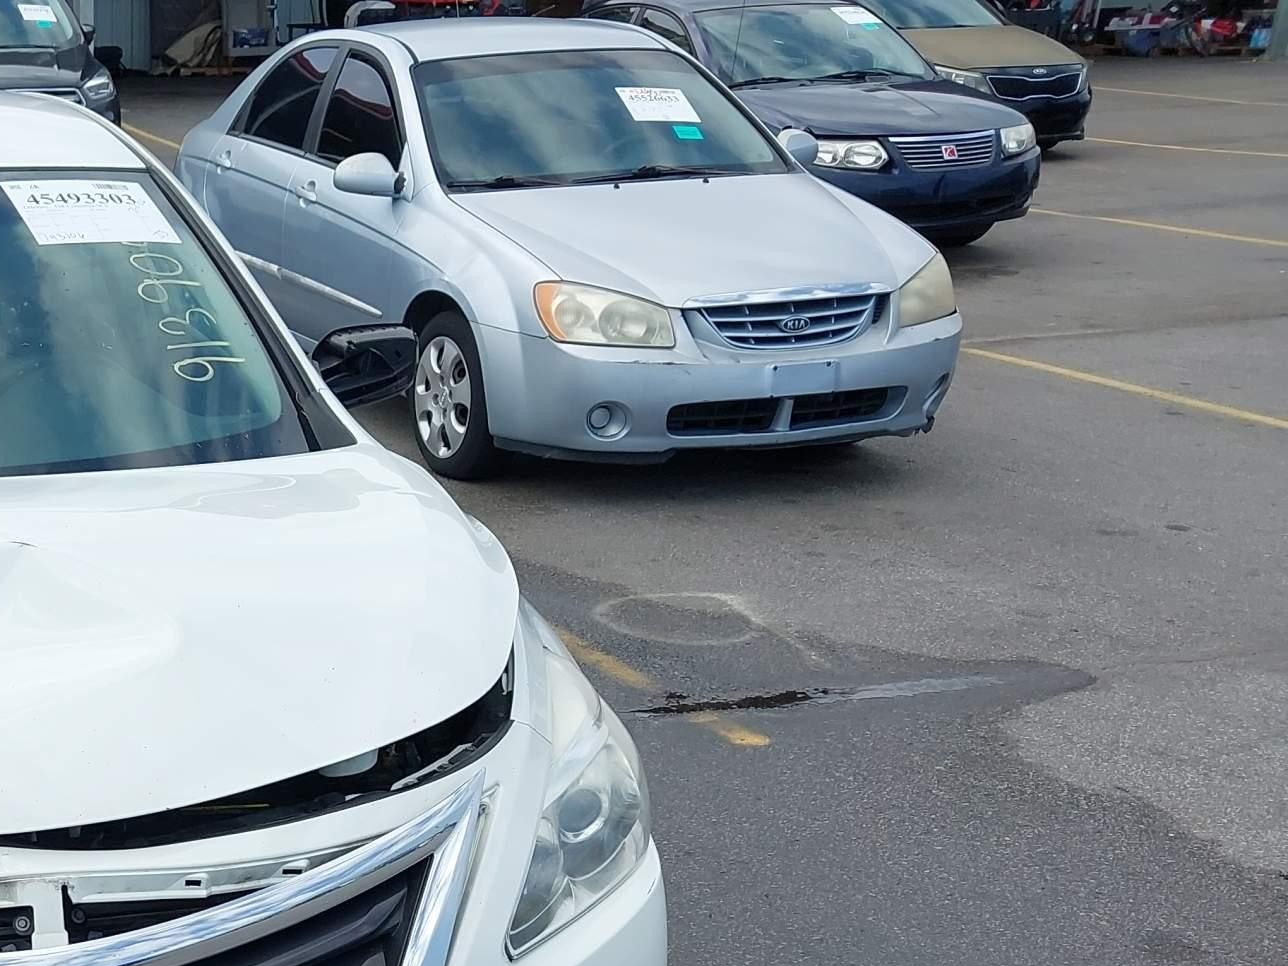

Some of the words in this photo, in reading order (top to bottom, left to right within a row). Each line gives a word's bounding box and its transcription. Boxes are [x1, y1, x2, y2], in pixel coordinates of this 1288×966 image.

[26, 192, 137, 205] 45493303
[123, 241, 245, 382] 91390
[787, 319, 806, 329] KIA
